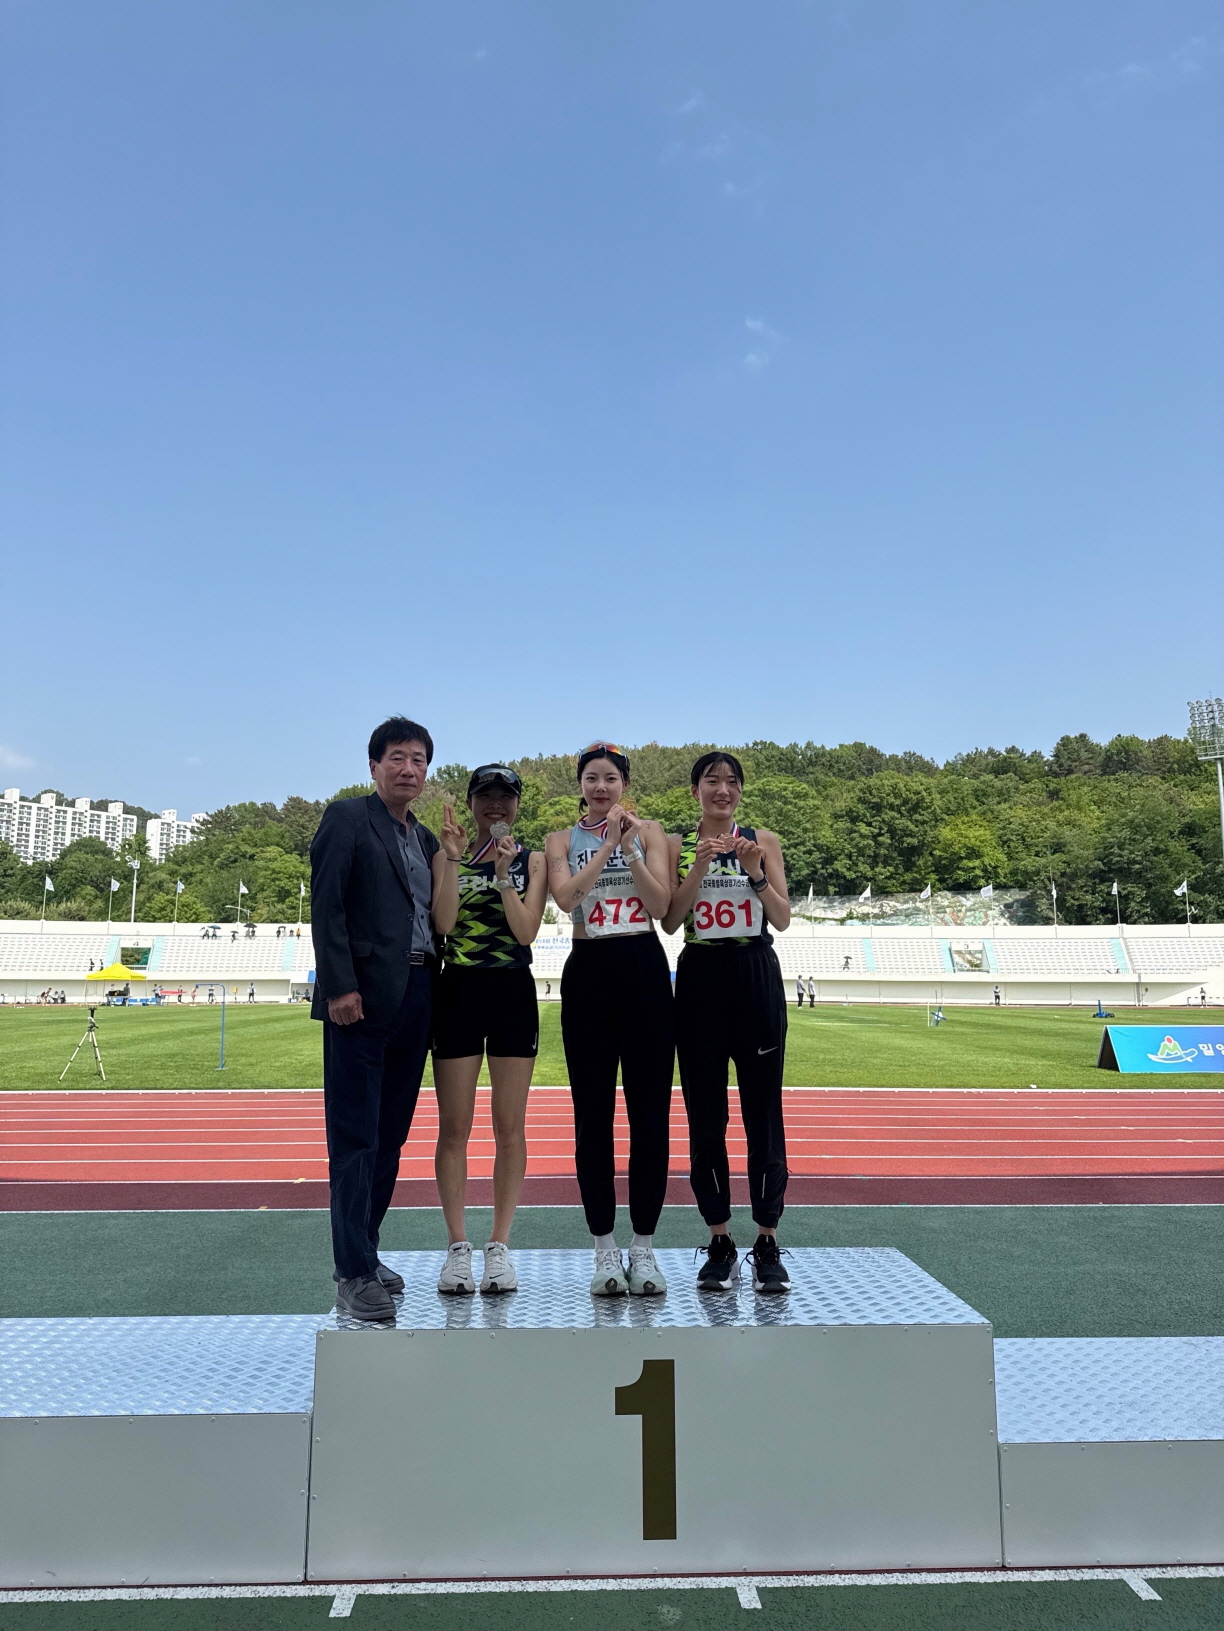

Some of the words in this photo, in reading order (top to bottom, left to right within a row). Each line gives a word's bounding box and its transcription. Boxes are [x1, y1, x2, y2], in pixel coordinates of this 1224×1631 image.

[577, 846, 630, 870] 진군
[588, 897, 646, 927] 472
[695, 899, 752, 930] 361
[615, 1359, 677, 1541] 1
